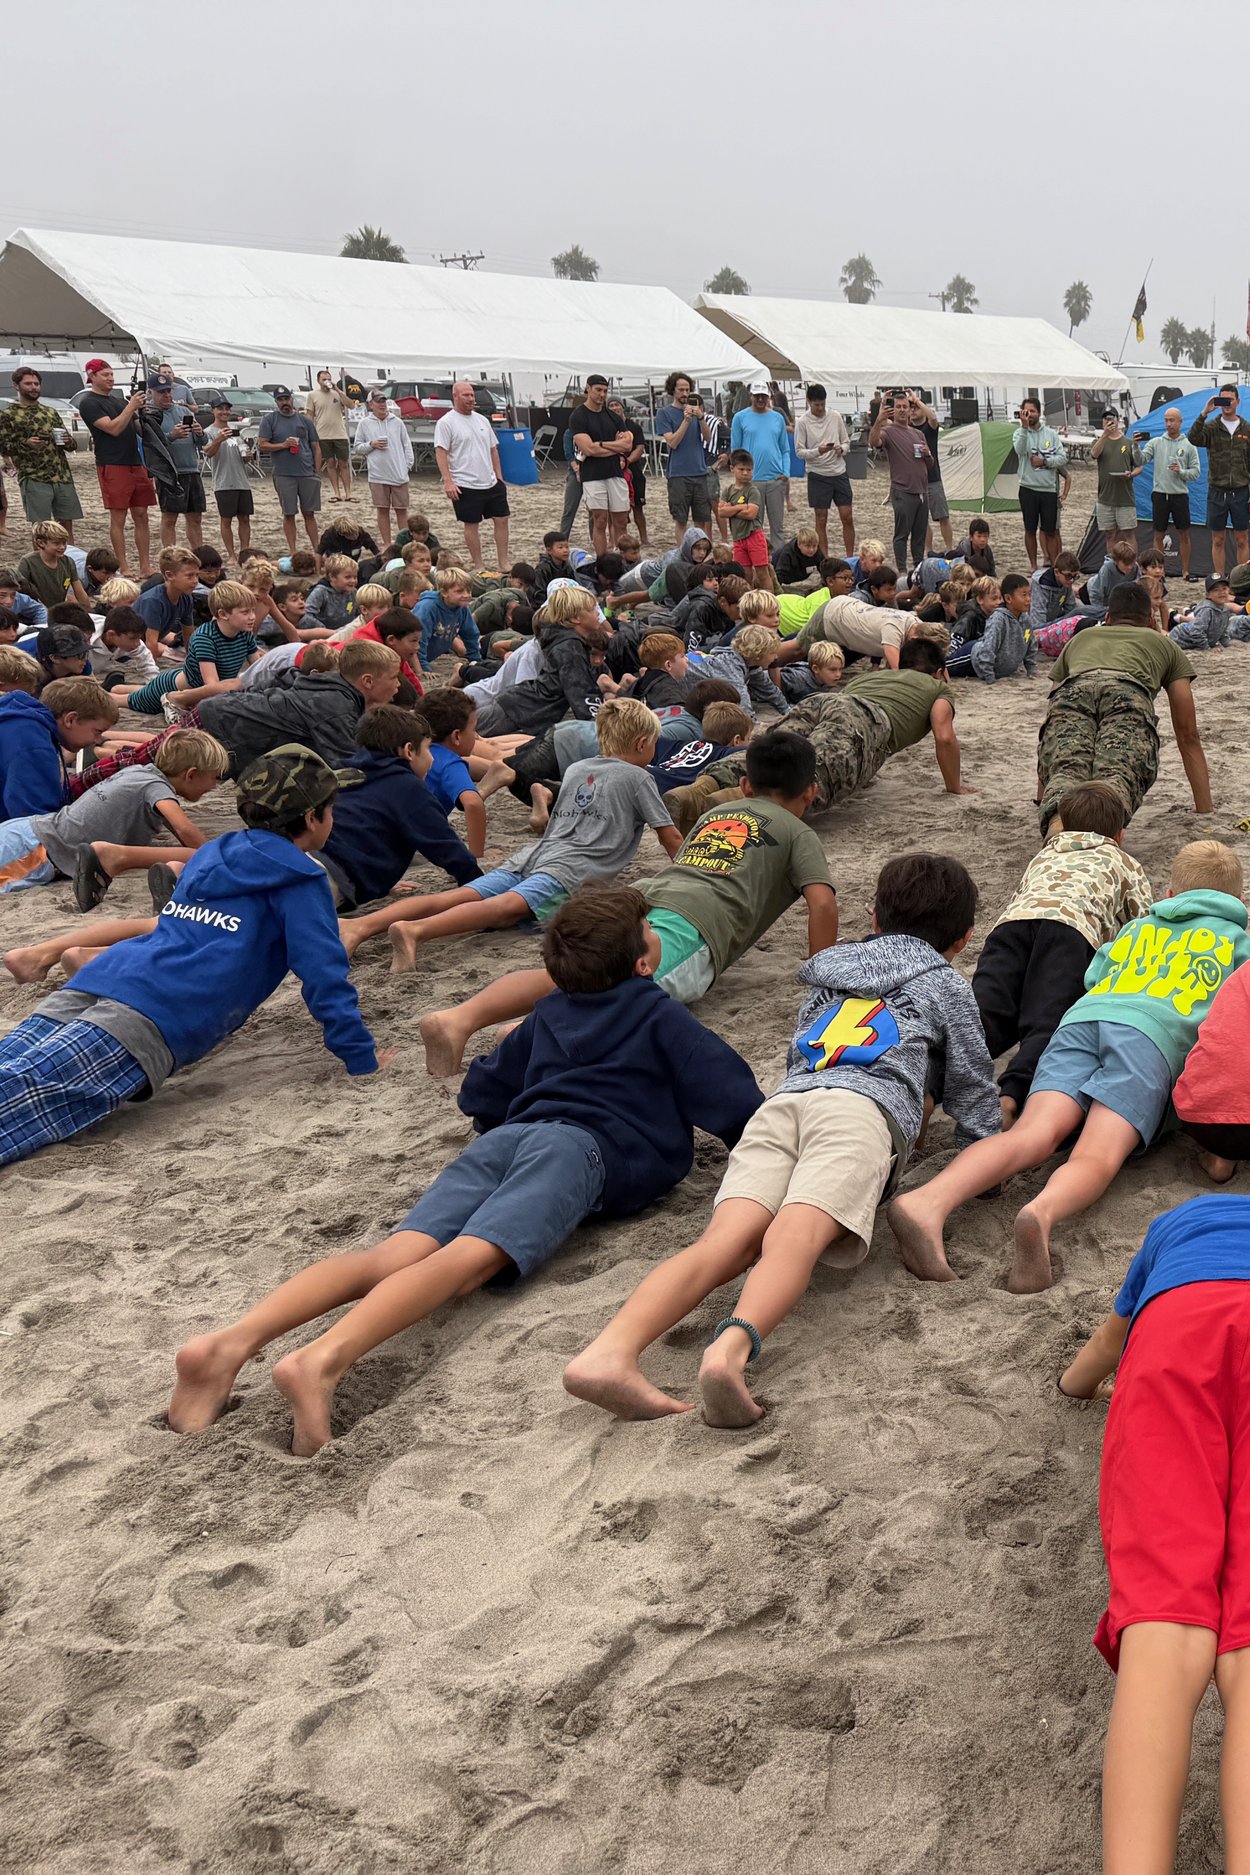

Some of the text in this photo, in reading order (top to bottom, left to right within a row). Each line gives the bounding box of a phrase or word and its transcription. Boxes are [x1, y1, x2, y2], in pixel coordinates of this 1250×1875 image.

[676, 855, 731, 871] CAMPOUT
[161, 900, 242, 932] OHAWKS
[883, 986, 921, 1021] OLTS
